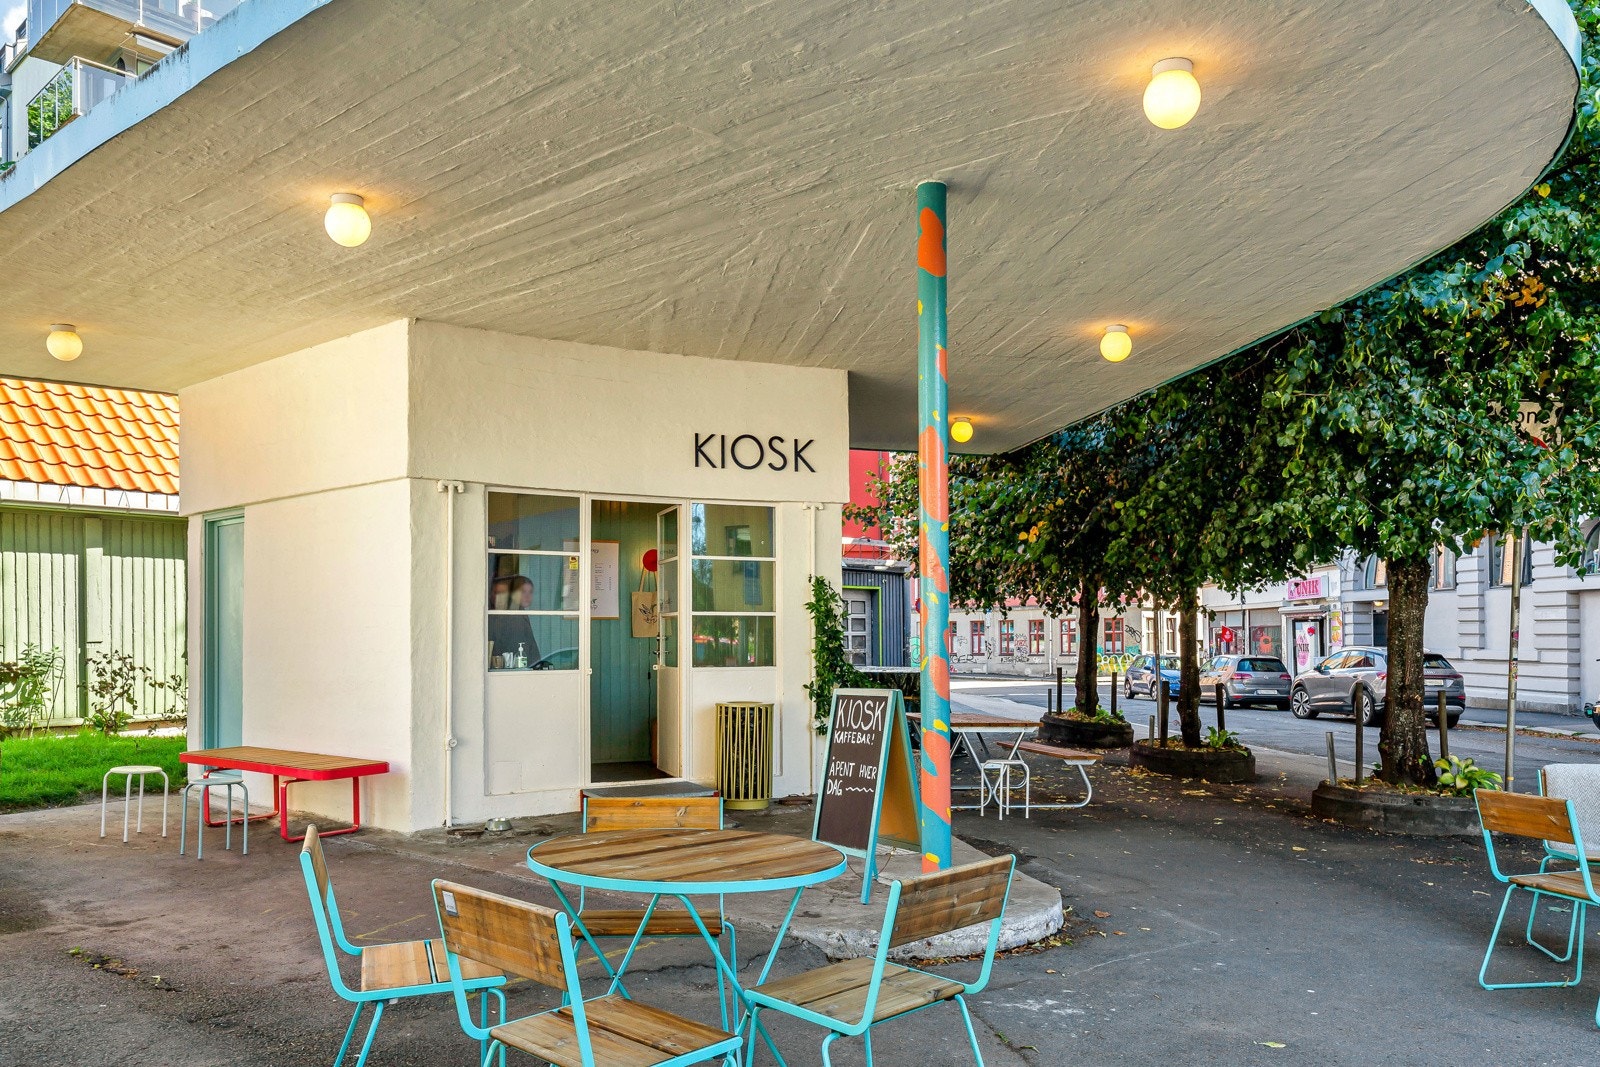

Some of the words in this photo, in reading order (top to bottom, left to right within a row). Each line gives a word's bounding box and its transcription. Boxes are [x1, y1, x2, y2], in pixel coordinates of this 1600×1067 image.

[695, 433, 816, 472] KIOSK
[836, 699, 886, 731] KIOSK
[859, 764, 878, 779] HVER
[826, 778, 843, 796] DAG
